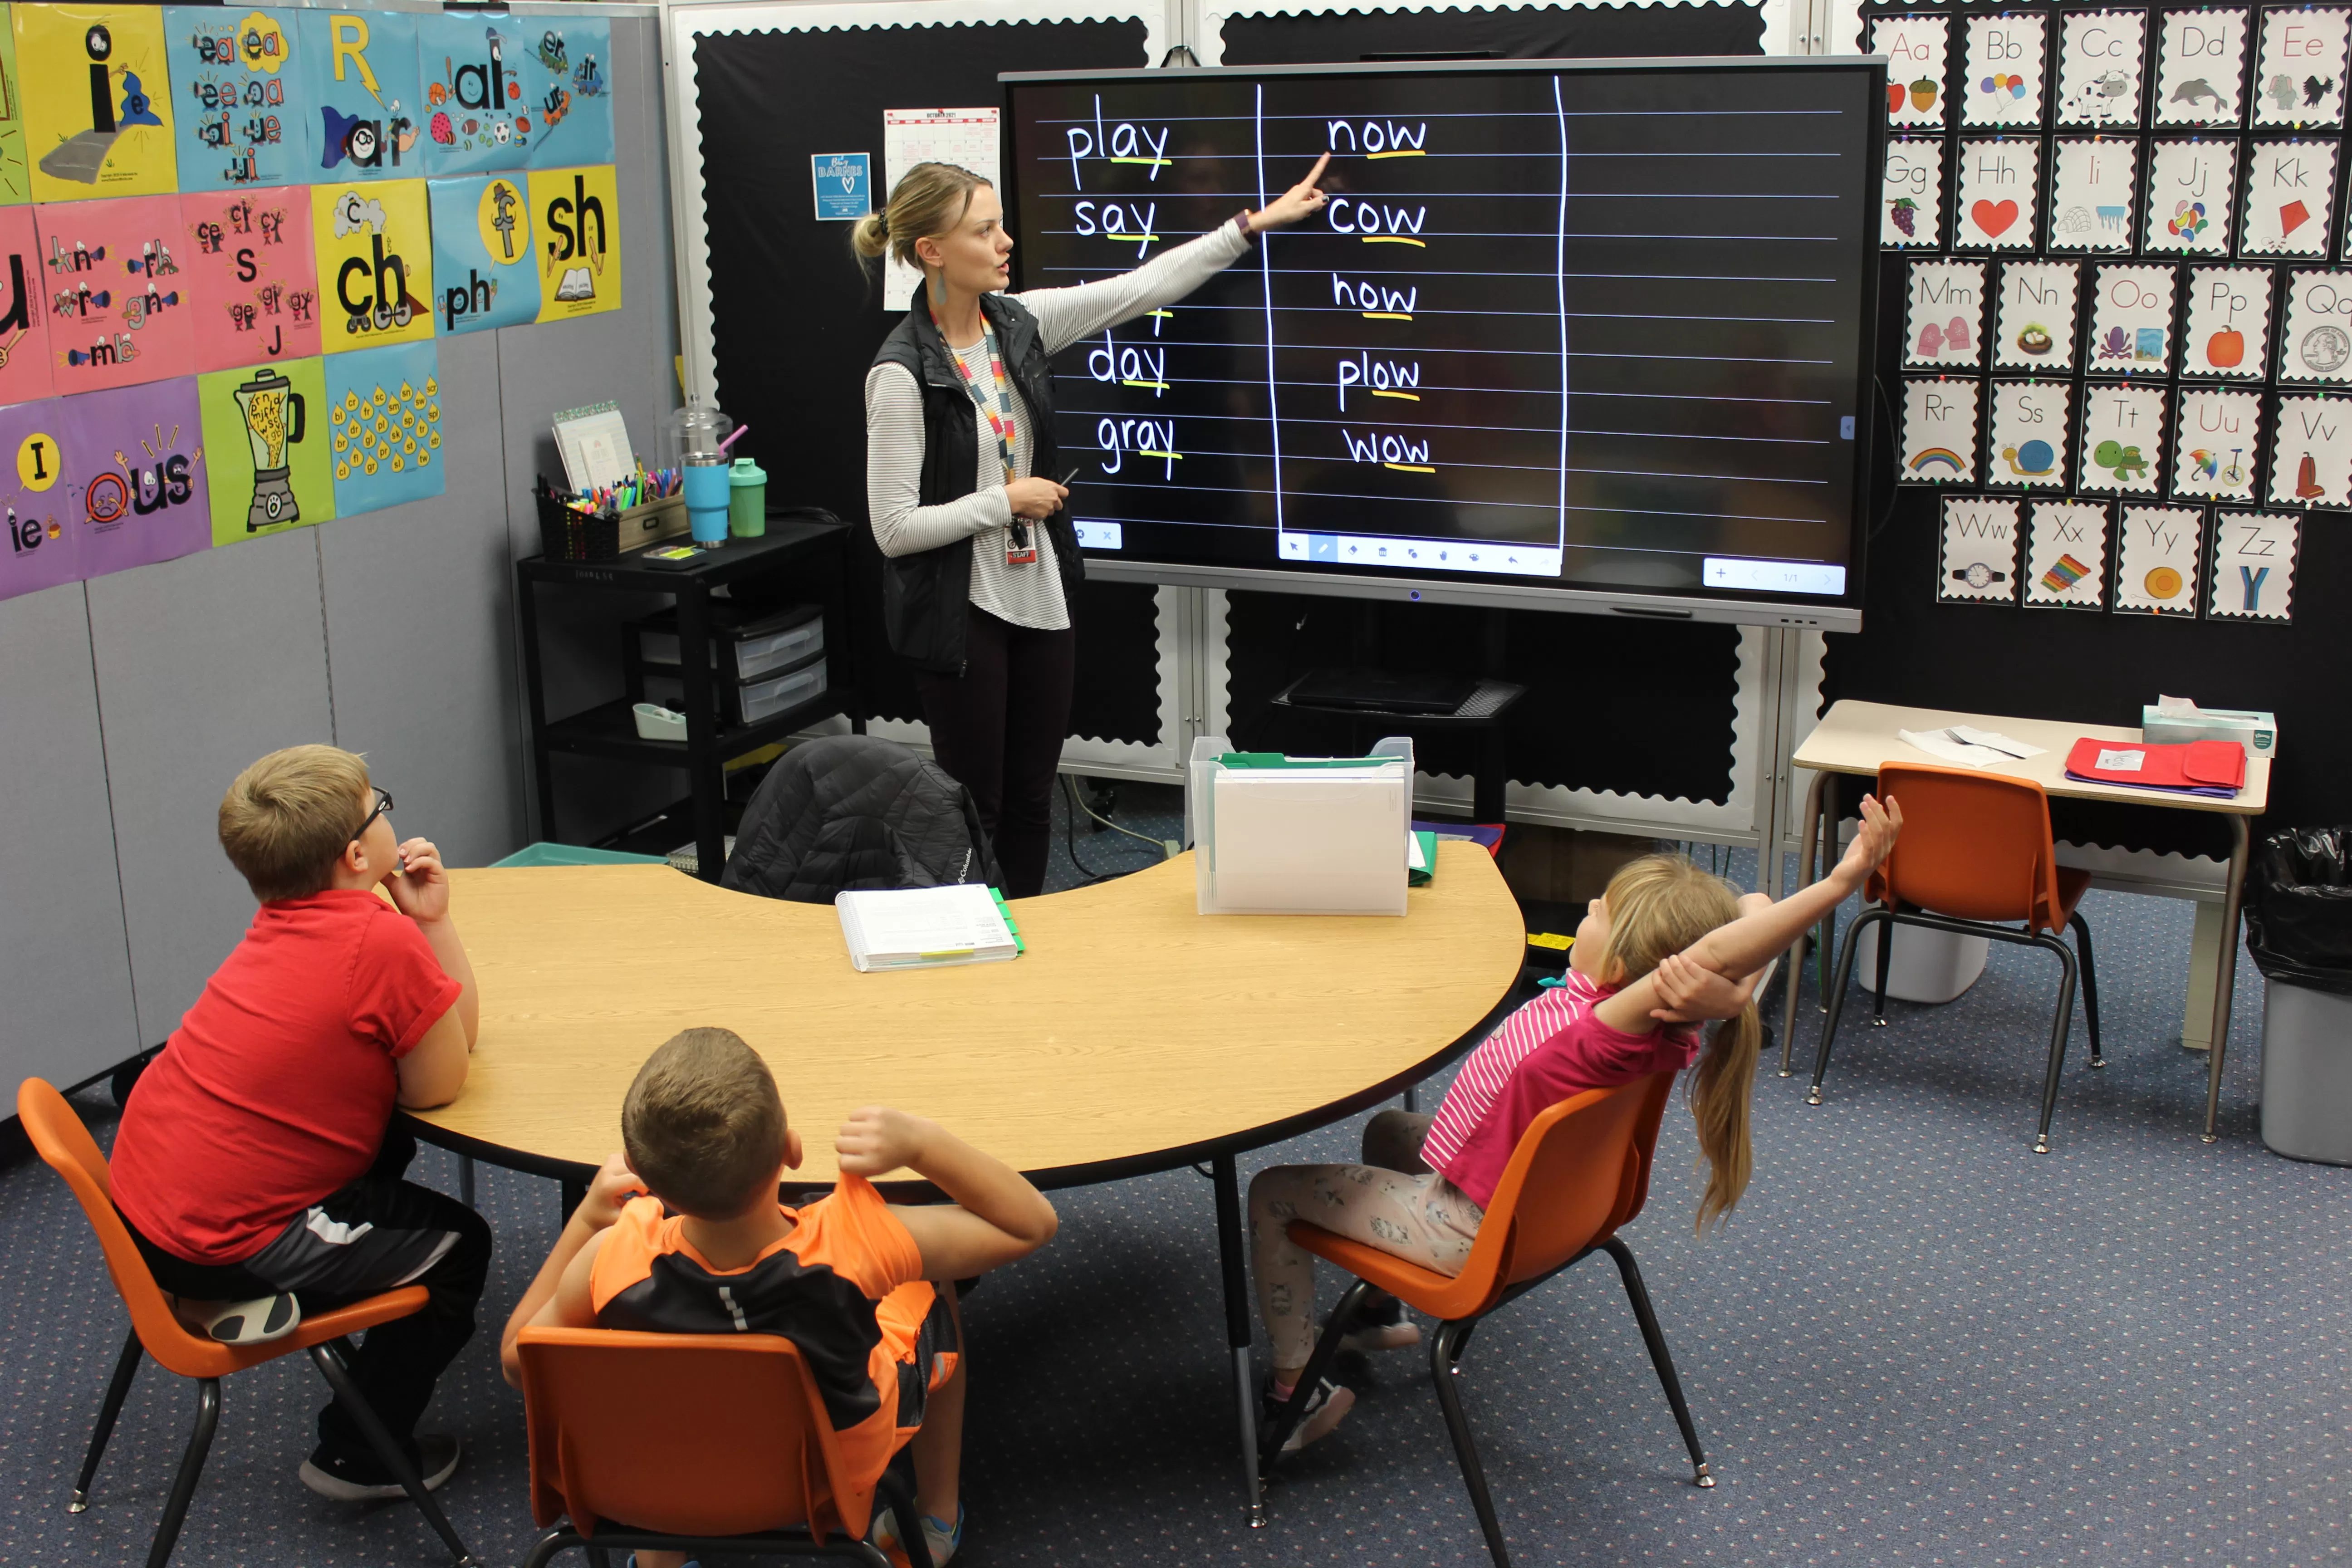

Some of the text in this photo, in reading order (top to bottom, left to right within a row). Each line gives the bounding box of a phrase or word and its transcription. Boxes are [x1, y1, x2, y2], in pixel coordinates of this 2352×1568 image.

[200, 36, 235, 63] ea
[247, 31, 280, 60] ea
[1889, 33, 1930, 61] Aa
[1987, 30, 2023, 60] Bb
[2081, 28, 2123, 58] Cc
[2181, 26, 2226, 58] Dd
[2283, 26, 2324, 58] Ee
[330, 15, 387, 112] R
[456, 38, 505, 110] al
[131, 94, 144, 115] e
[202, 82, 237, 108] ee
[206, 112, 230, 145] ai
[250, 115, 281, 142] ue
[348, 116, 412, 167] ar
[1067, 93, 1168, 191] play
[1327, 119, 1427, 152] now
[232, 148, 256, 180] ui
[818, 165, 863, 178] BARNES
[1885, 156, 1927, 195] Gg
[1978, 156, 2016, 185] Hh
[2089, 155, 2101, 185] Ii
[2177, 157, 2208, 197] Jj
[2273, 157, 2309, 188] Kk
[547, 175, 606, 261] sh
[1075, 201, 1156, 260] say
[1328, 197, 1426, 234] cow
[51, 236, 92, 274] kn
[337, 233, 407, 317] ch
[54, 290, 92, 318] wr
[446, 269, 491, 331] ph
[1332, 272, 1417, 313] how
[1921, 276, 1972, 305] Mm
[2018, 276, 2058, 306] Nn
[2111, 280, 2158, 309] Oo
[2210, 282, 2247, 323] Pp
[126, 291, 162, 330] gn
[2306, 284, 2352, 328] Qq
[90, 333, 136, 367] mb
[267, 325, 281, 356] J
[1088, 328, 1164, 398] day
[1339, 350, 1420, 413] plow
[348, 399, 356, 407] cr
[375, 394, 383, 402] sc
[388, 403, 399, 412] sm
[1925, 394, 1955, 421] Rr
[2018, 396, 2043, 424] Ss
[334, 412, 343, 421] bl
[377, 420, 385, 431] pl
[404, 417, 413, 427] sp
[2113, 400, 2139, 428] Tt
[2200, 404, 2239, 434] Uu
[2301, 411, 2337, 441] Vv
[337, 439, 346, 448] br
[350, 425, 358, 434] dr
[365, 435, 373, 446] gl
[392, 431, 401, 439] sk
[380, 447, 388, 458] pr
[406, 441, 413, 450] st
[419, 455, 428, 463] tw
[1098, 417, 1174, 481] gray
[30, 441, 48, 481] I
[339, 466, 346, 475] cl
[367, 462, 376, 473] gr
[394, 458, 401, 468] sl
[86, 454, 193, 523] ous
[9, 514, 43, 553] ie
[1955, 512, 2008, 540] Ww
[2053, 514, 2084, 543] Xx
[2144, 519, 2179, 555] Yy
[2237, 526, 2276, 557] Zz
[1783, 573, 1798, 583] 1/1
[960, 848, 972, 877] Columbia
